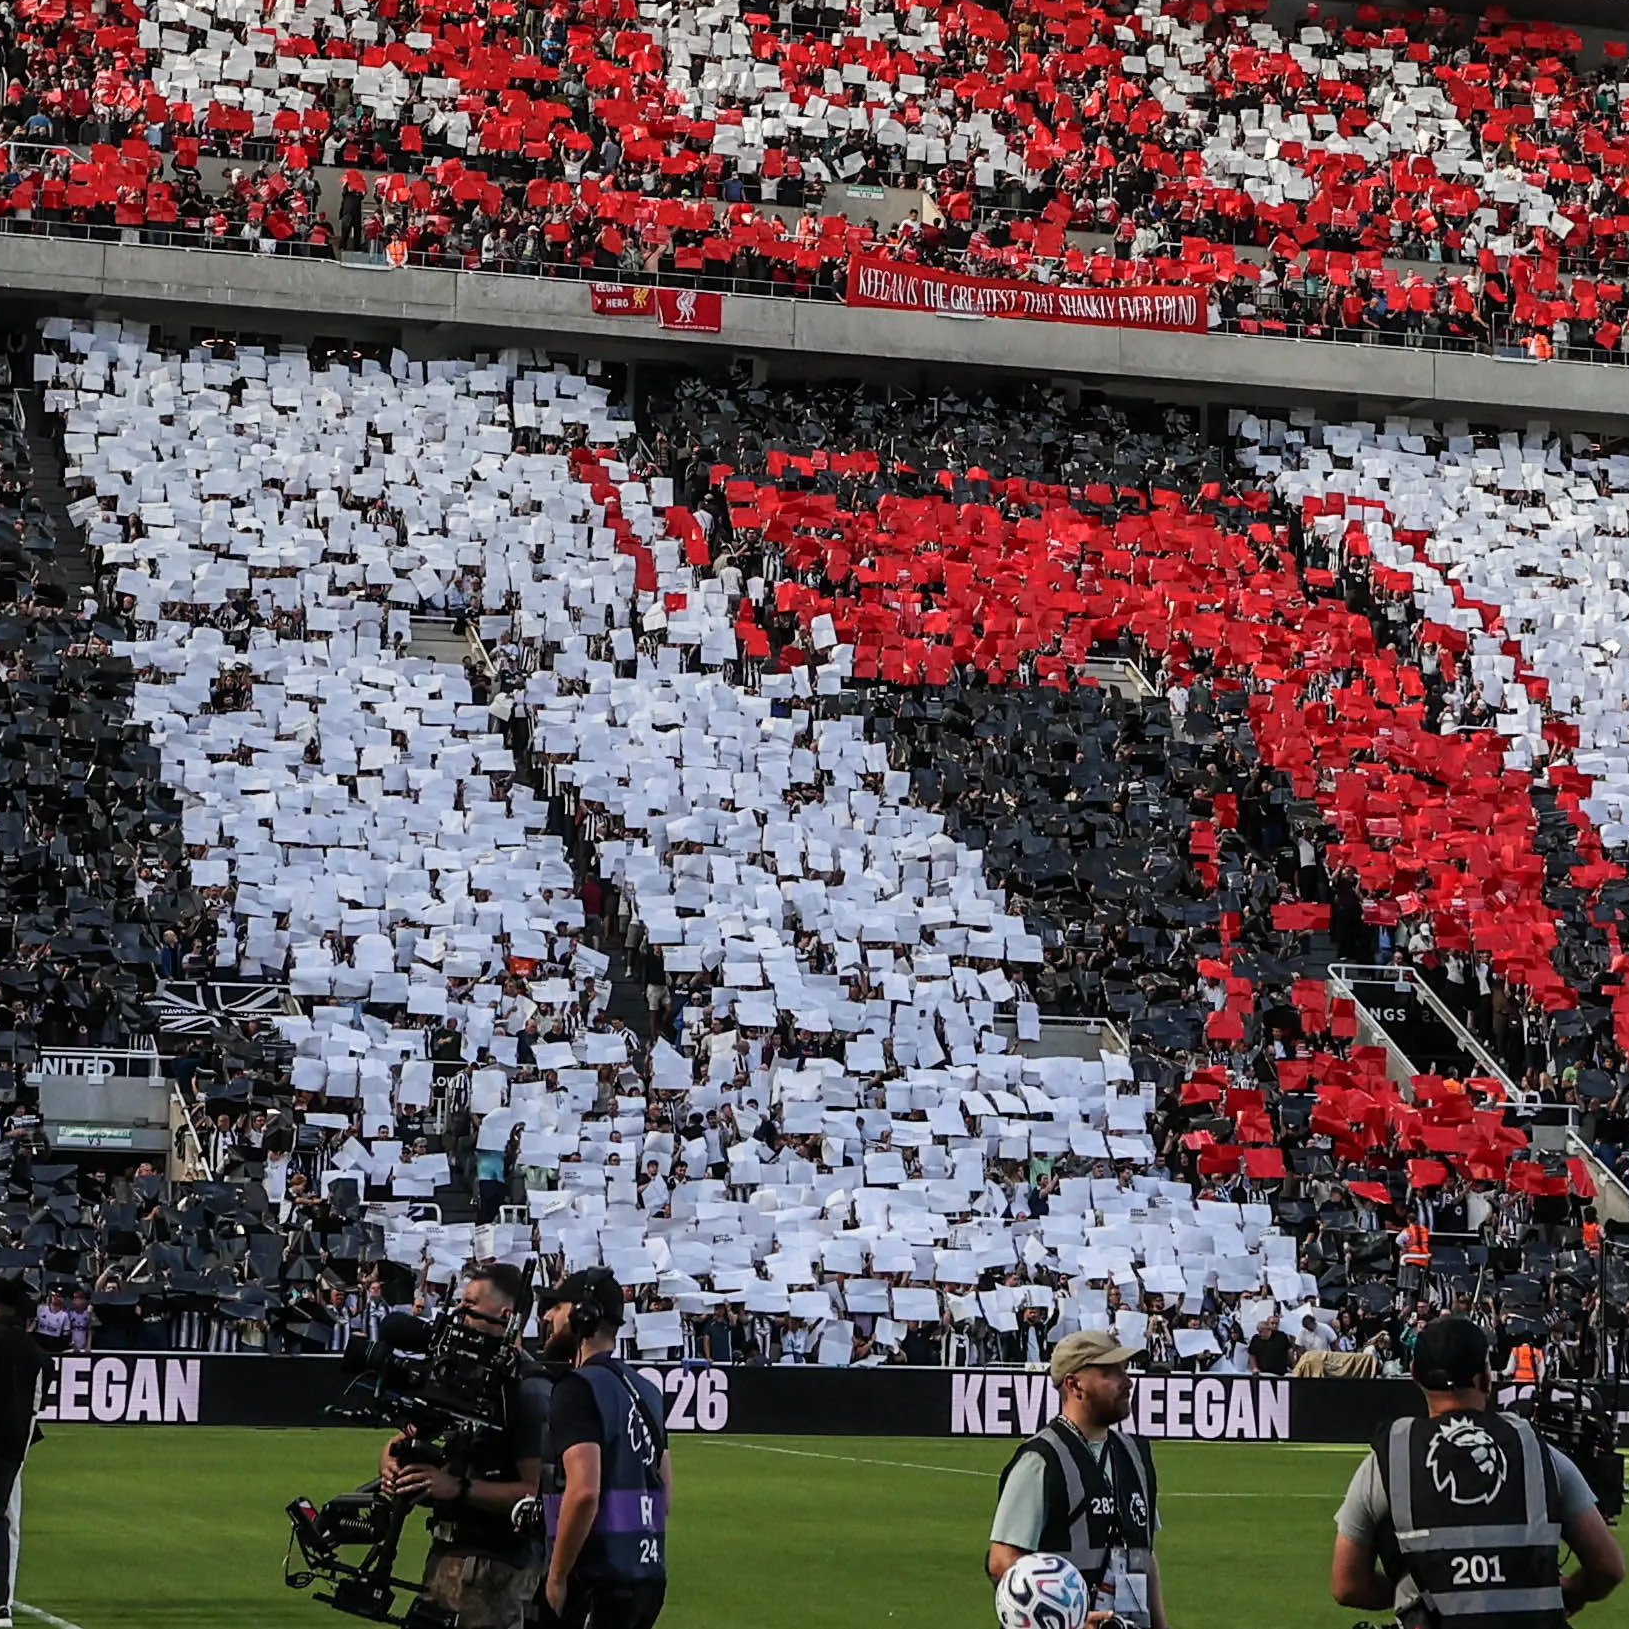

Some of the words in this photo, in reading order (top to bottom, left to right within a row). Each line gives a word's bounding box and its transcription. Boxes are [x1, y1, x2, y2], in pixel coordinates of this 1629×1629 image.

[605, 298, 629, 309] HERO
[907, 276, 919, 306] IS
[922, 279, 949, 310] THE
[1155, 294, 1197, 326] FOUND
[1370, 1007, 1406, 1022] NGS
[950, 1373, 1062, 1434] KEVI
[1450, 1554, 1507, 1585] 201
